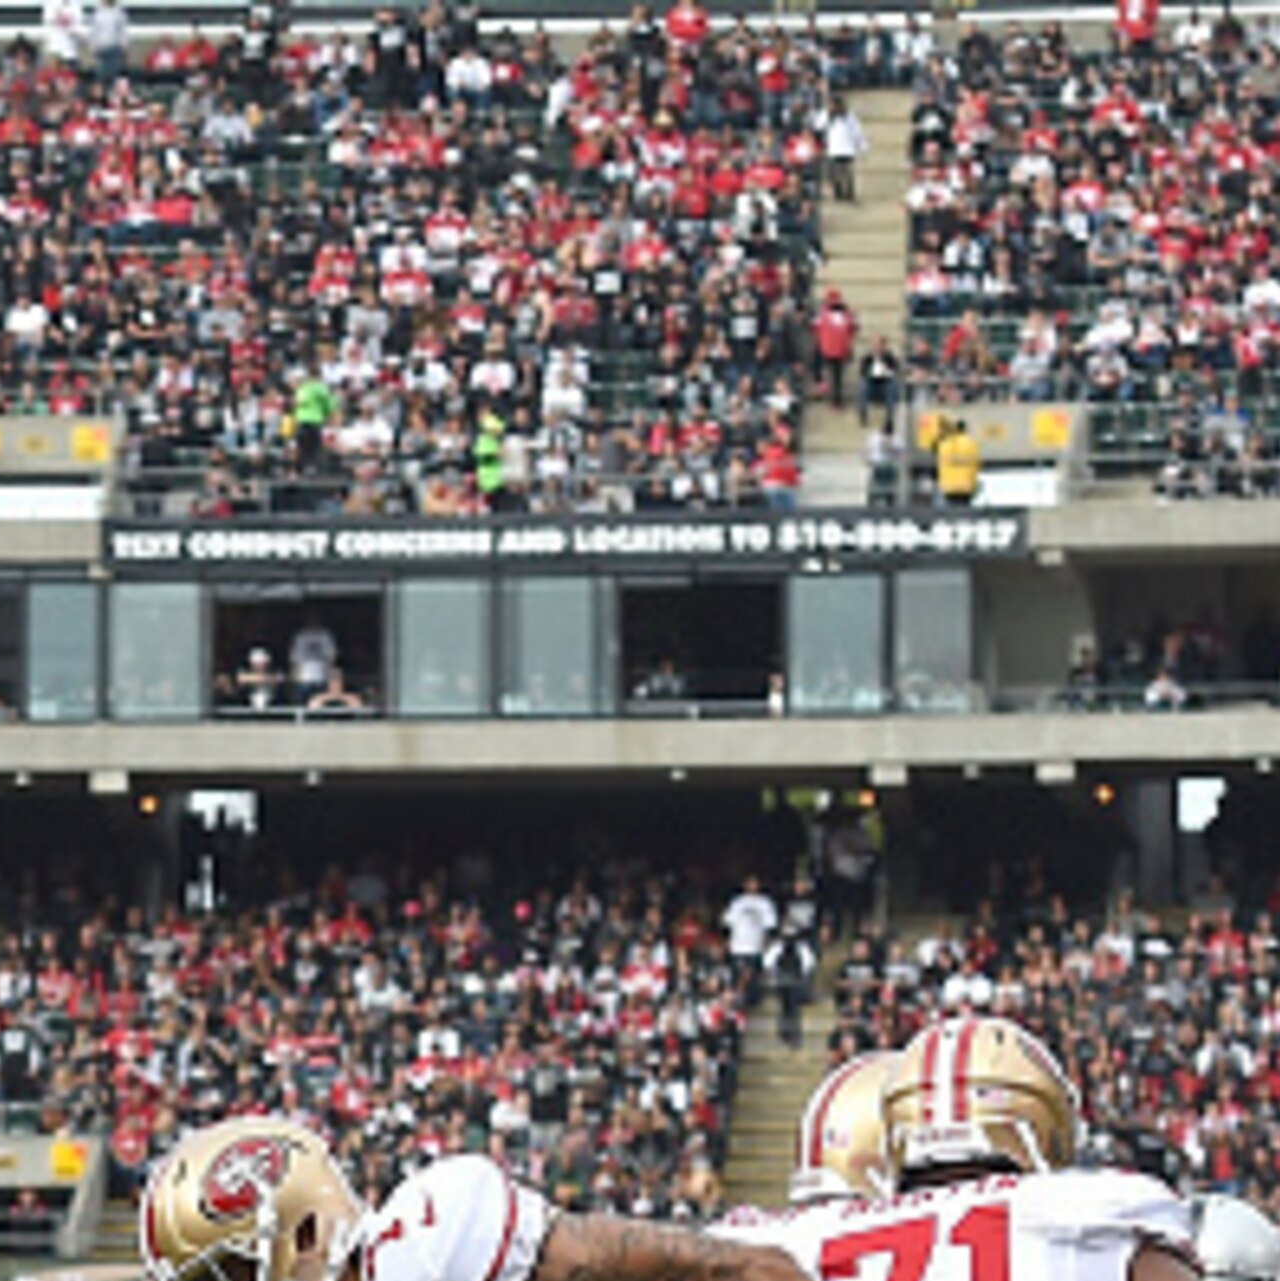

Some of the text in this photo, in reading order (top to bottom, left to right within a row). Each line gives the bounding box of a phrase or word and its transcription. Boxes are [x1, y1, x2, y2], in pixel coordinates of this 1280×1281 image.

[185, 531, 329, 559] CONDUCT
[496, 525, 568, 554] AND
[573, 524, 723, 553] LOCATION
[730, 522, 770, 552] TO
